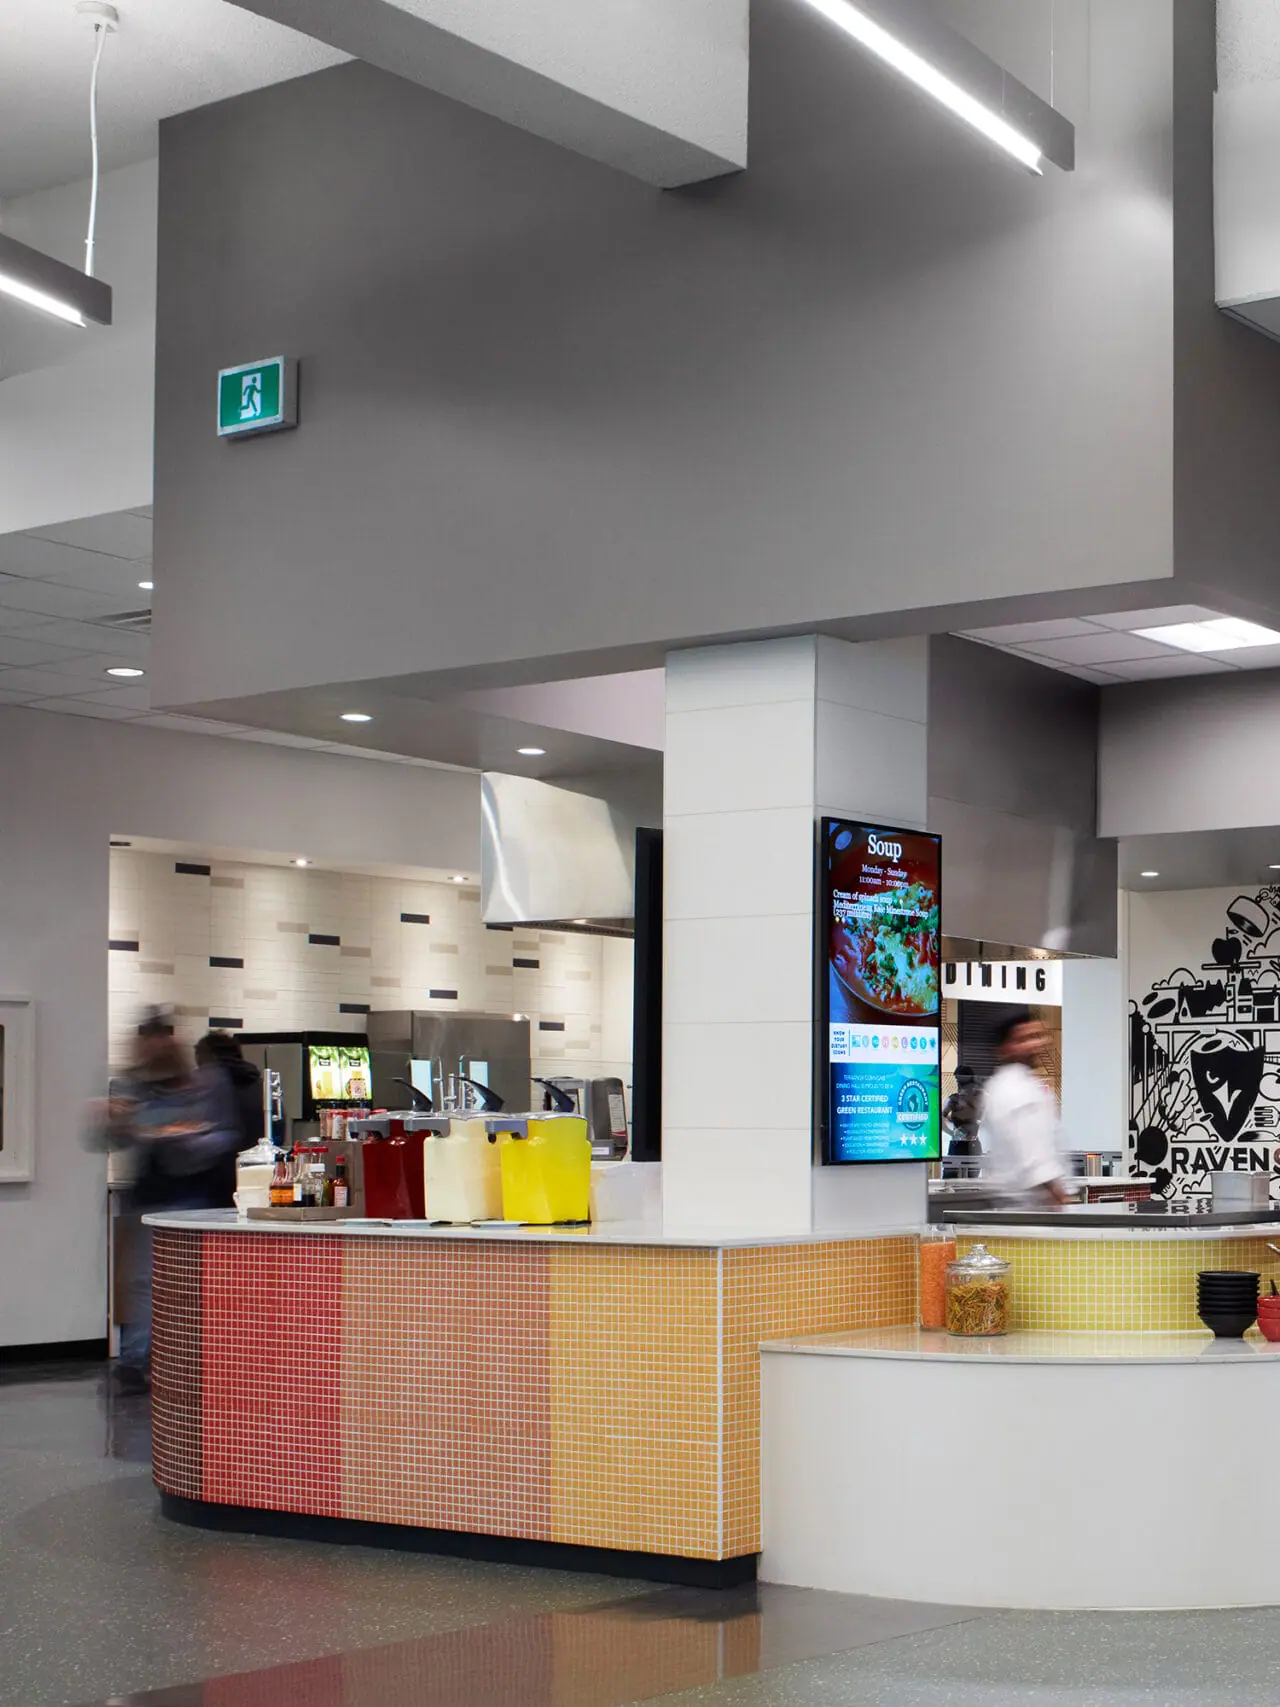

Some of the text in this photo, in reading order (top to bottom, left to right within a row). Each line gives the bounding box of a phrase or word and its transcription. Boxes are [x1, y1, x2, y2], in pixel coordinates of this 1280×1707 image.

[867, 834, 902, 863] Soup
[862, 864, 883, 876] Monday
[887, 867, 908, 879] Sunday
[833, 889, 851, 900] Cream
[945, 962, 1045, 991] DINING
[837, 1106, 893, 1114] GREEN RESTAURANT
